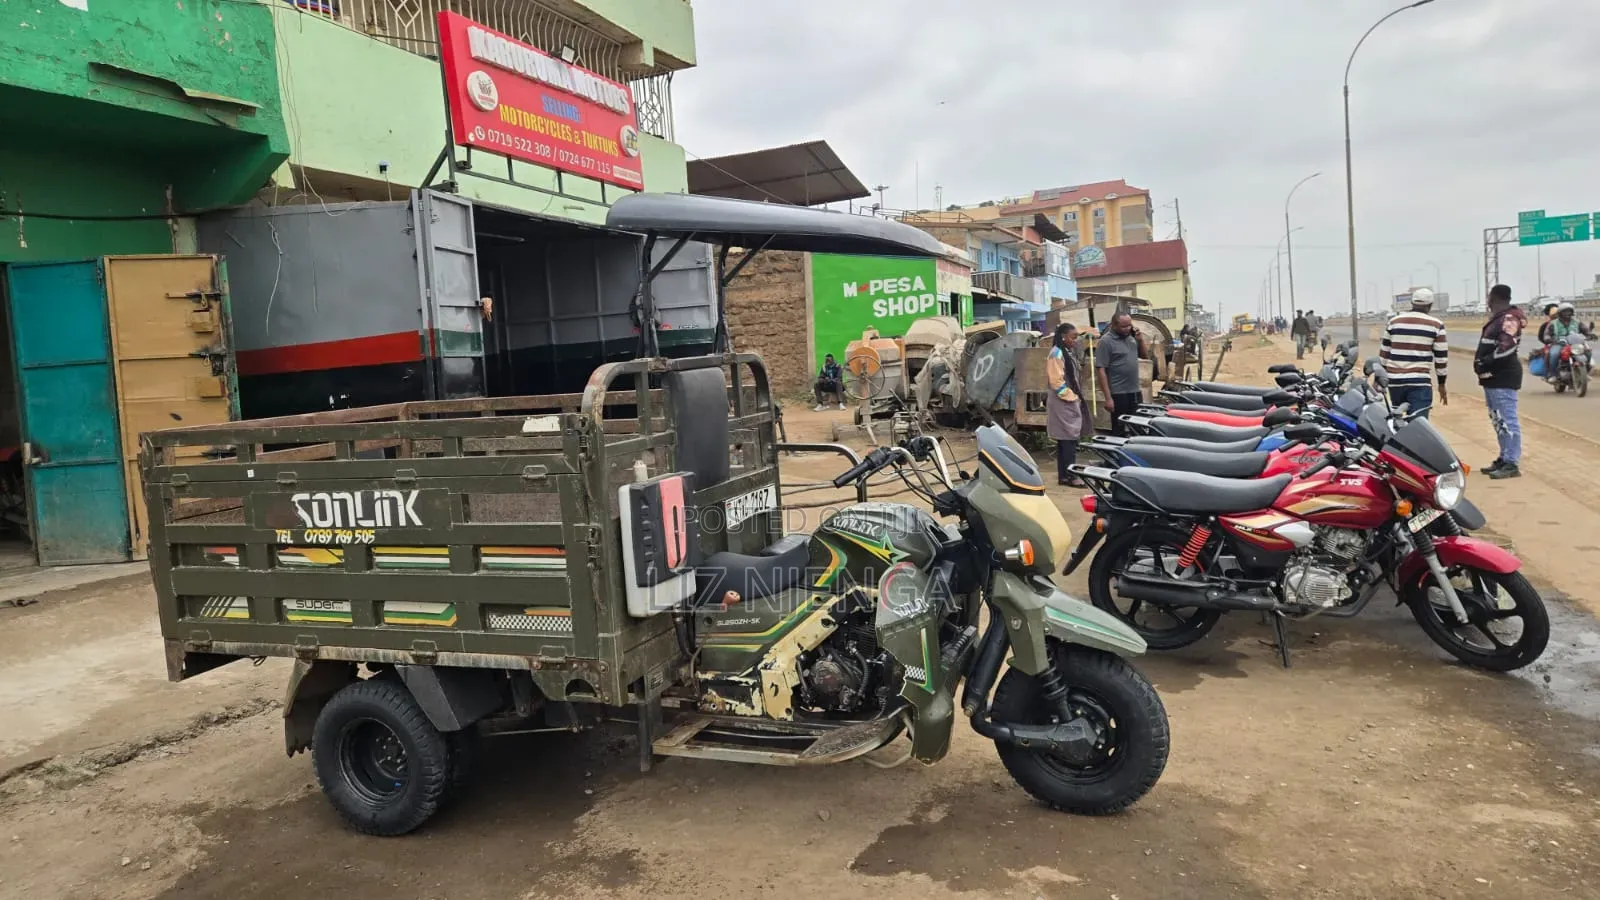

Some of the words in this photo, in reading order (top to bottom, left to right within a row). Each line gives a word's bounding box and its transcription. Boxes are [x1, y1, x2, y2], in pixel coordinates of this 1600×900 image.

[571, 67, 631, 115] MOTORS
[499, 104, 572, 144] MOTORCYCLES
[574, 131, 581, 145] &
[581, 131, 619, 157] TUKTUKS
[488, 129, 513, 147] 0719
[514, 138, 533, 153] 522
[534, 142, 551, 158] 308
[559, 150, 579, 166] 0724
[581, 156, 596, 170] 677
[597, 160, 611, 175] 115
[843, 276, 926, 298] M-PESA
[873, 294, 934, 317] SHOP
[1339, 478, 1363, 486] TVS
[275, 530, 294, 544] TEL
[304, 529, 332, 544] 0789
[354, 529, 375, 544] 505
